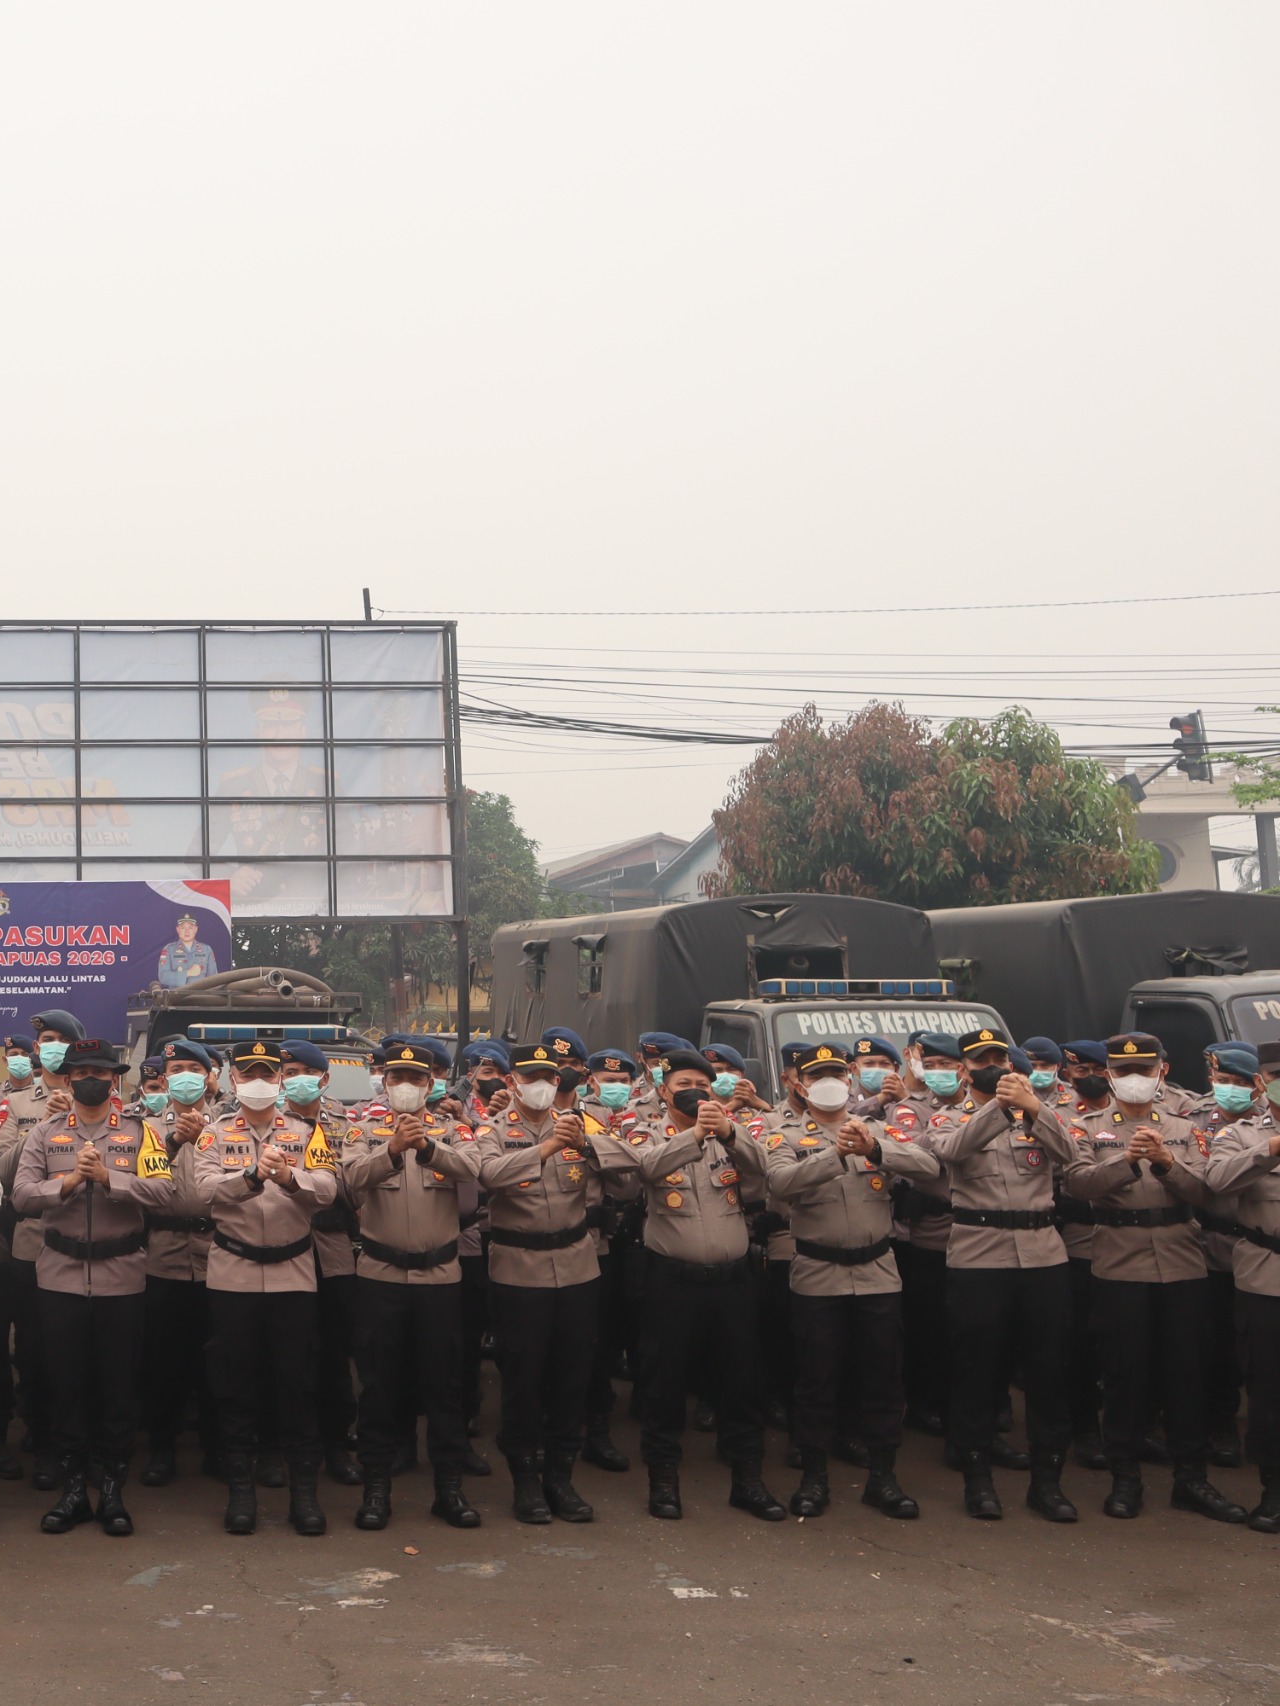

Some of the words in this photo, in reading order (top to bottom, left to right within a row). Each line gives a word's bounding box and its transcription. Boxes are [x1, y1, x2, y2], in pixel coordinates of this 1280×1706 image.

[67, 951, 116, 965] 2026
[43, 975, 69, 983] LALU
[71, 975, 107, 983] LINTAS
[796, 1012, 877, 1036] POLRES
[877, 1012, 982, 1034] KETAPANG
[47, 1146, 69, 1154] PUTRA
[107, 1145, 137, 1154] POLRI
[144, 1157, 158, 1173] KA
